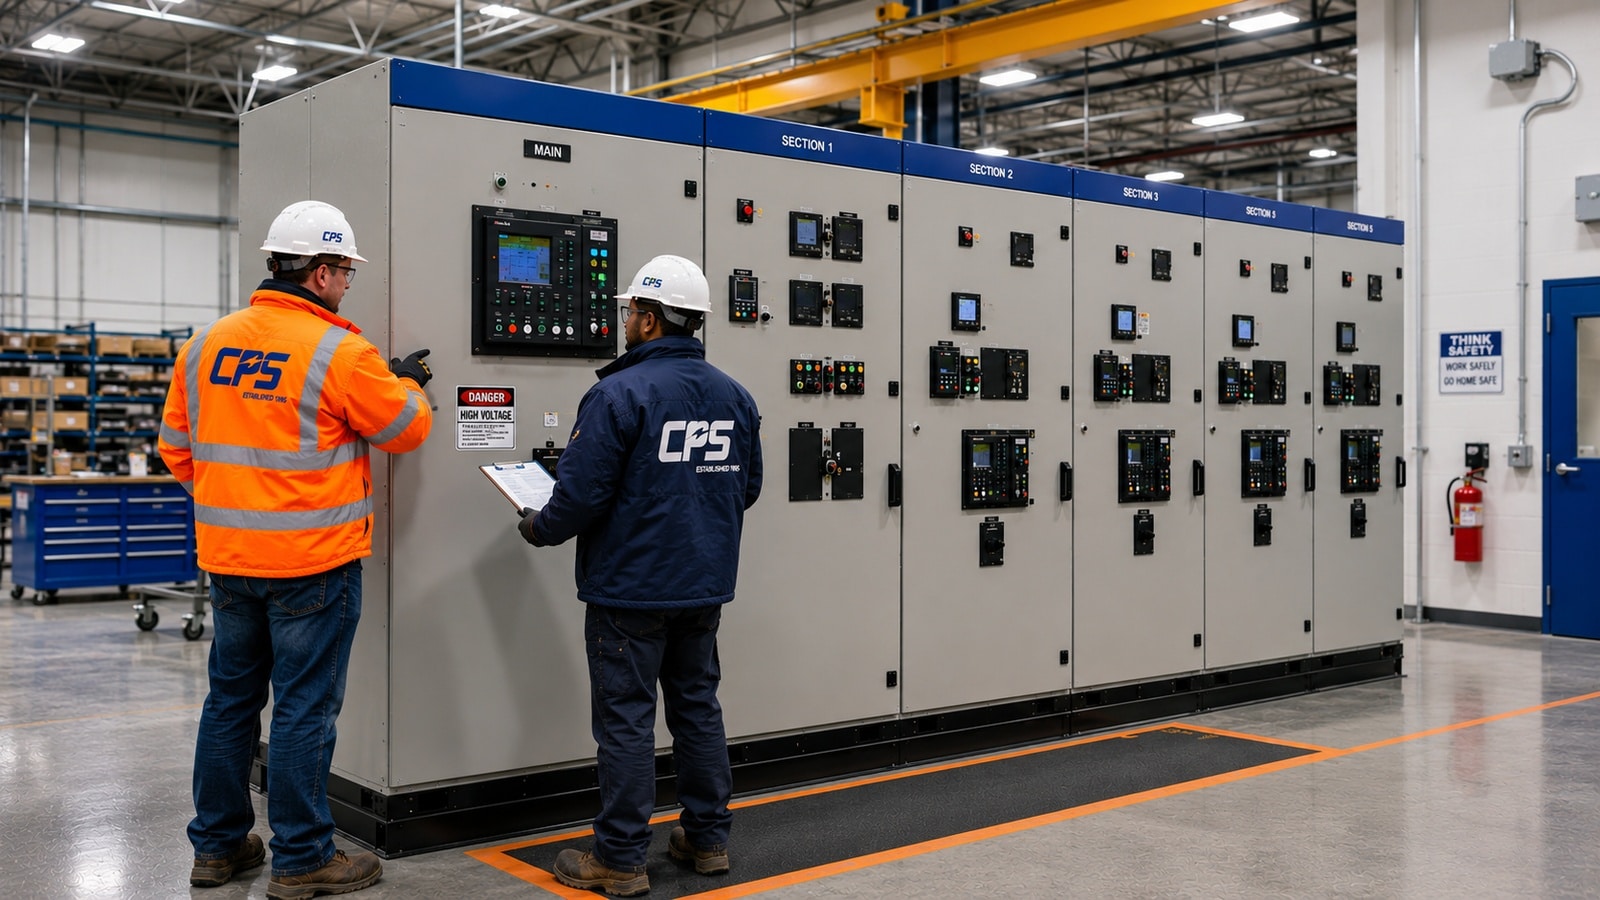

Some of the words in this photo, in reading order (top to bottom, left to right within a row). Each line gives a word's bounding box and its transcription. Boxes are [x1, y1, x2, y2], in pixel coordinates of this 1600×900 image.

[782, 135, 825, 152] SECTION
[828, 142, 833, 153] 1
[534, 143, 562, 158] MAIN
[969, 163, 1006, 178] SECTION
[1007, 169, 1014, 179] 2
[1123, 186, 1153, 201] SECTION
[1153, 191, 1159, 201] 3
[1246, 206, 1271, 218] SECTION
[1347, 221, 1369, 233] SECTION
[322, 231, 343, 243] CPS
[642, 276, 663, 288] CPS
[1450, 334, 1491, 345] THINK
[1448, 345, 1494, 356] SAFETY
[209, 347, 291, 390] CPS
[1446, 362, 1467, 371] WORK
[1469, 361, 1496, 371] SAFELY
[1456, 376, 1476, 385] HOME
[1479, 376, 1497, 385] SAFE
[468, 392, 505, 403] DANGER
[460, 410, 479, 420] HIGH
[480, 410, 512, 421] VOLTAGE
[658, 420, 735, 463] CPS
